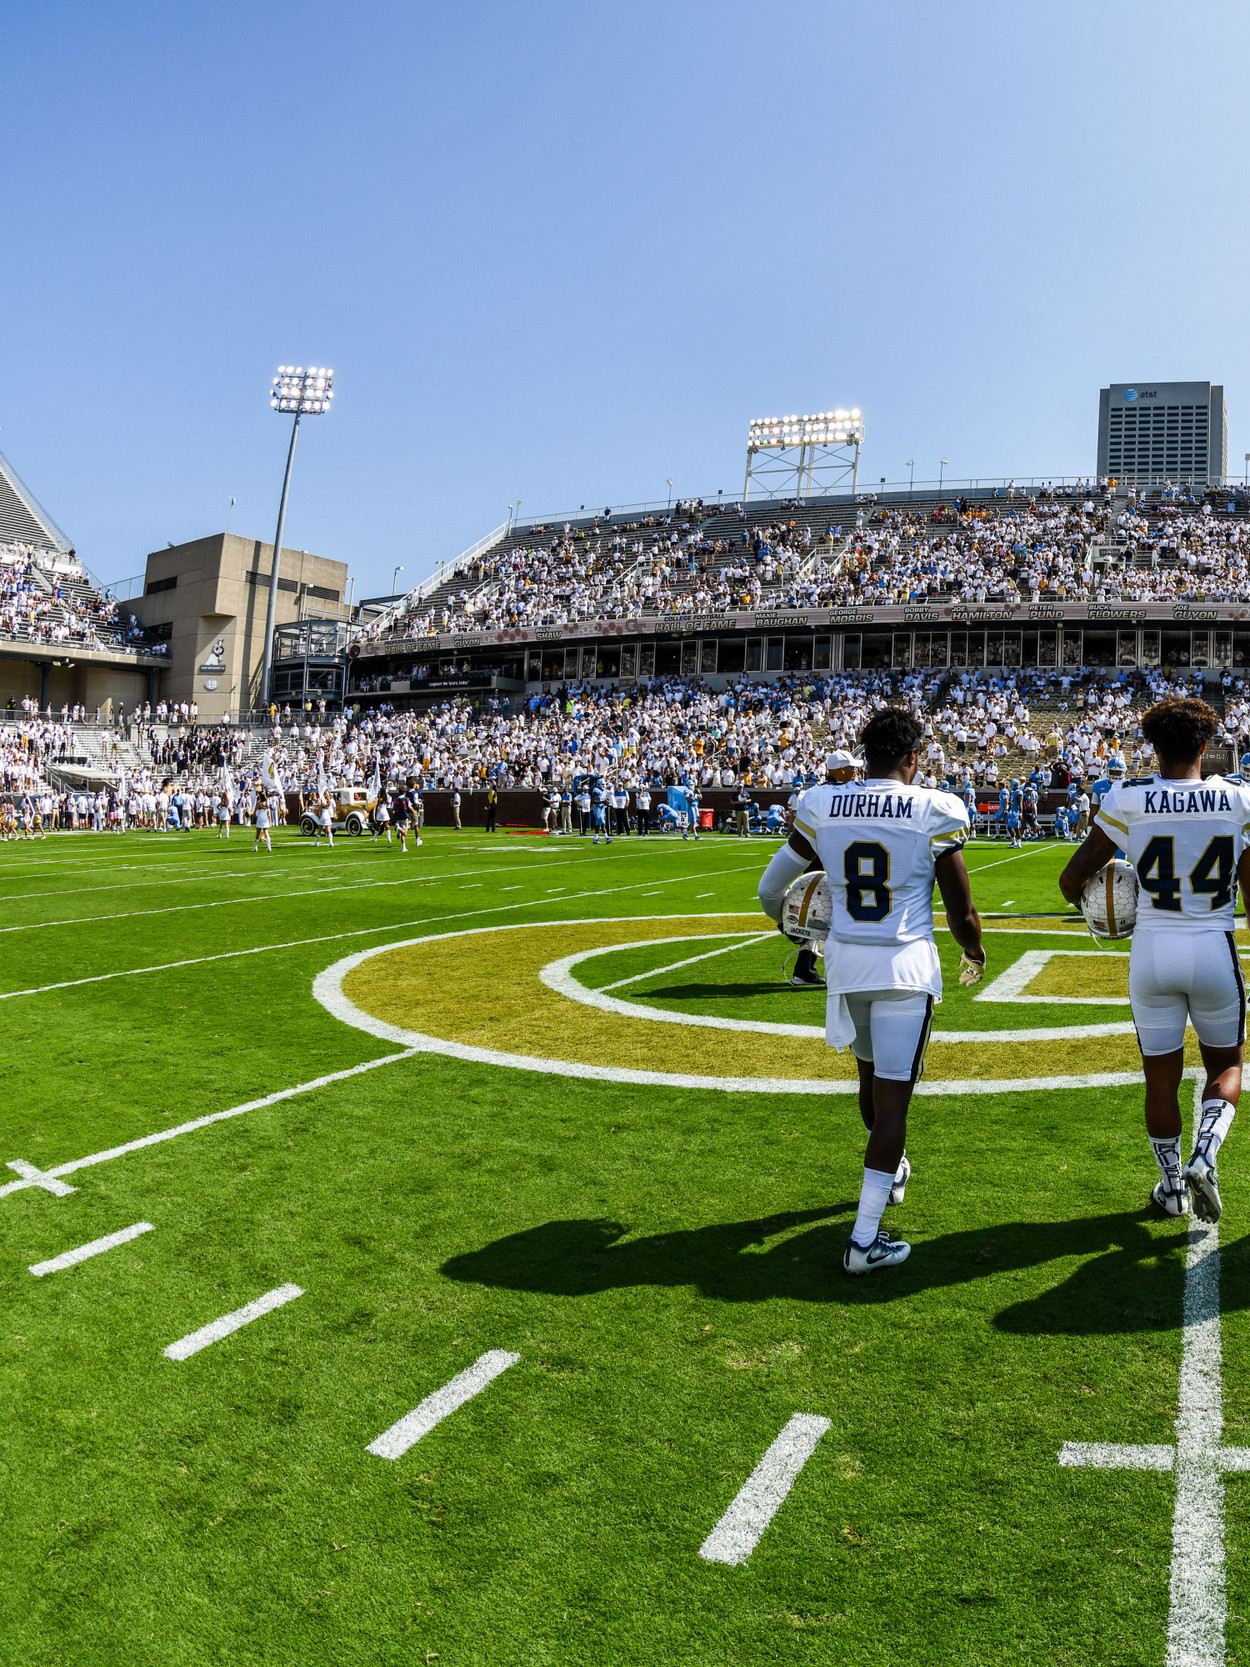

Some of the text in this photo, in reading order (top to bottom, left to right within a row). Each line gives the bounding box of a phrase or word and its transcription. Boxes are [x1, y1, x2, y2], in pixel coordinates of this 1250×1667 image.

[829, 608, 858, 616] GEORGE
[904, 612, 939, 621] DAVIS
[952, 611, 1013, 621] HAMILTON
[1029, 610, 1064, 619] PUND
[1088, 610, 1146, 619] FLOWERS
[1173, 611, 1218, 619] GUYON
[756, 617, 808, 627] BAUGHAN
[830, 614, 873, 624] MORRIS
[655, 619, 737, 633] HALL OF FAME
[536, 631, 562, 640] SHAW
[385, 641, 440, 654] HALL OF FAME
[454, 639, 480, 647] GUYON
[829, 794, 914, 819] DURHAM
[1144, 790, 1232, 814] KAGAWA
[1137, 835, 1235, 912] 44
[844, 840, 892, 923] 8
[791, 927, 811, 937] JACKETS
